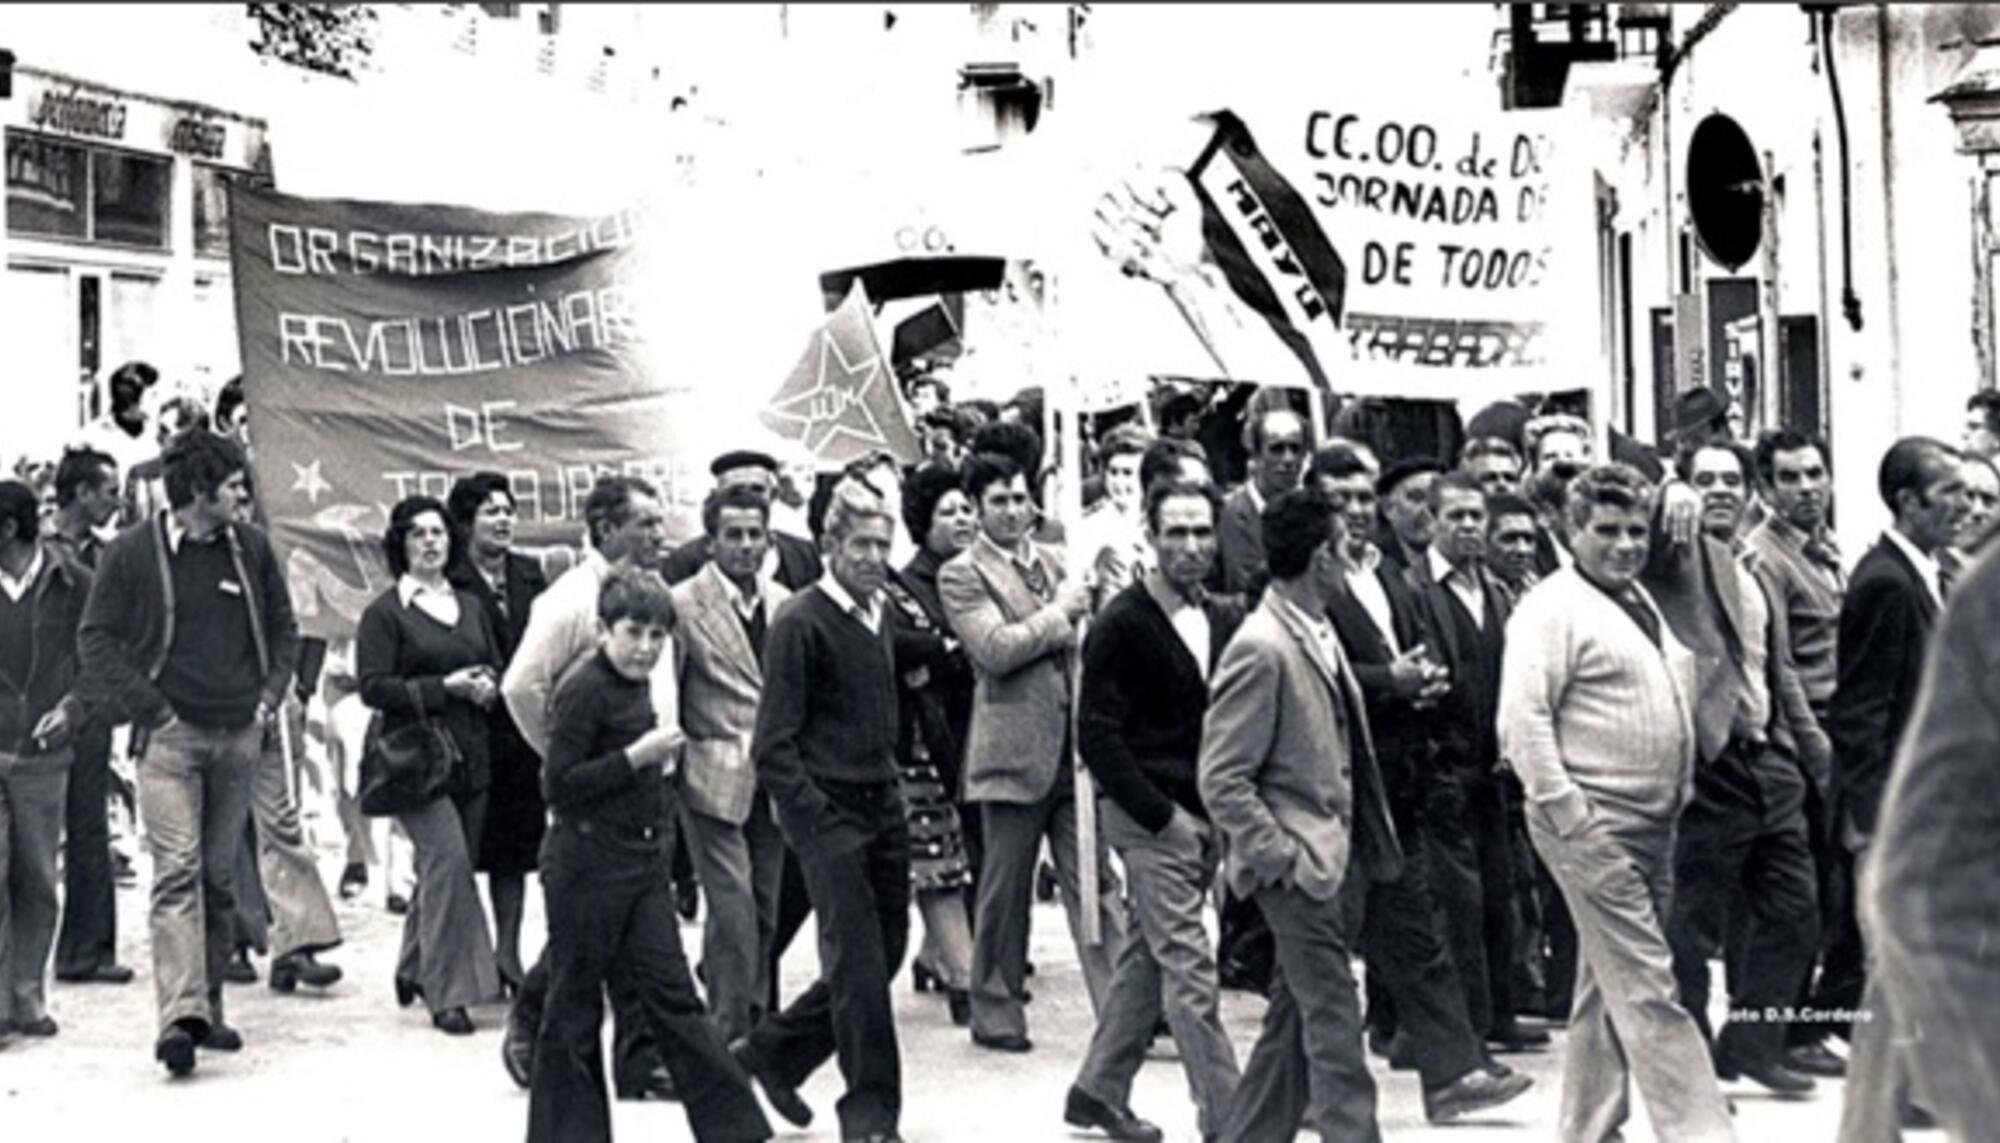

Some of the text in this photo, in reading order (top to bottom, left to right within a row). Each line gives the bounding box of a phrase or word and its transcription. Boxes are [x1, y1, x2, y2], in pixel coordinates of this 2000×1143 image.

[1305, 110, 1443, 171] CC.OO.
[1455, 131, 1497, 179] de
[1315, 172, 1498, 225] JORNADA
[1362, 241, 1416, 286] DE
[444, 401, 524, 452] DE
